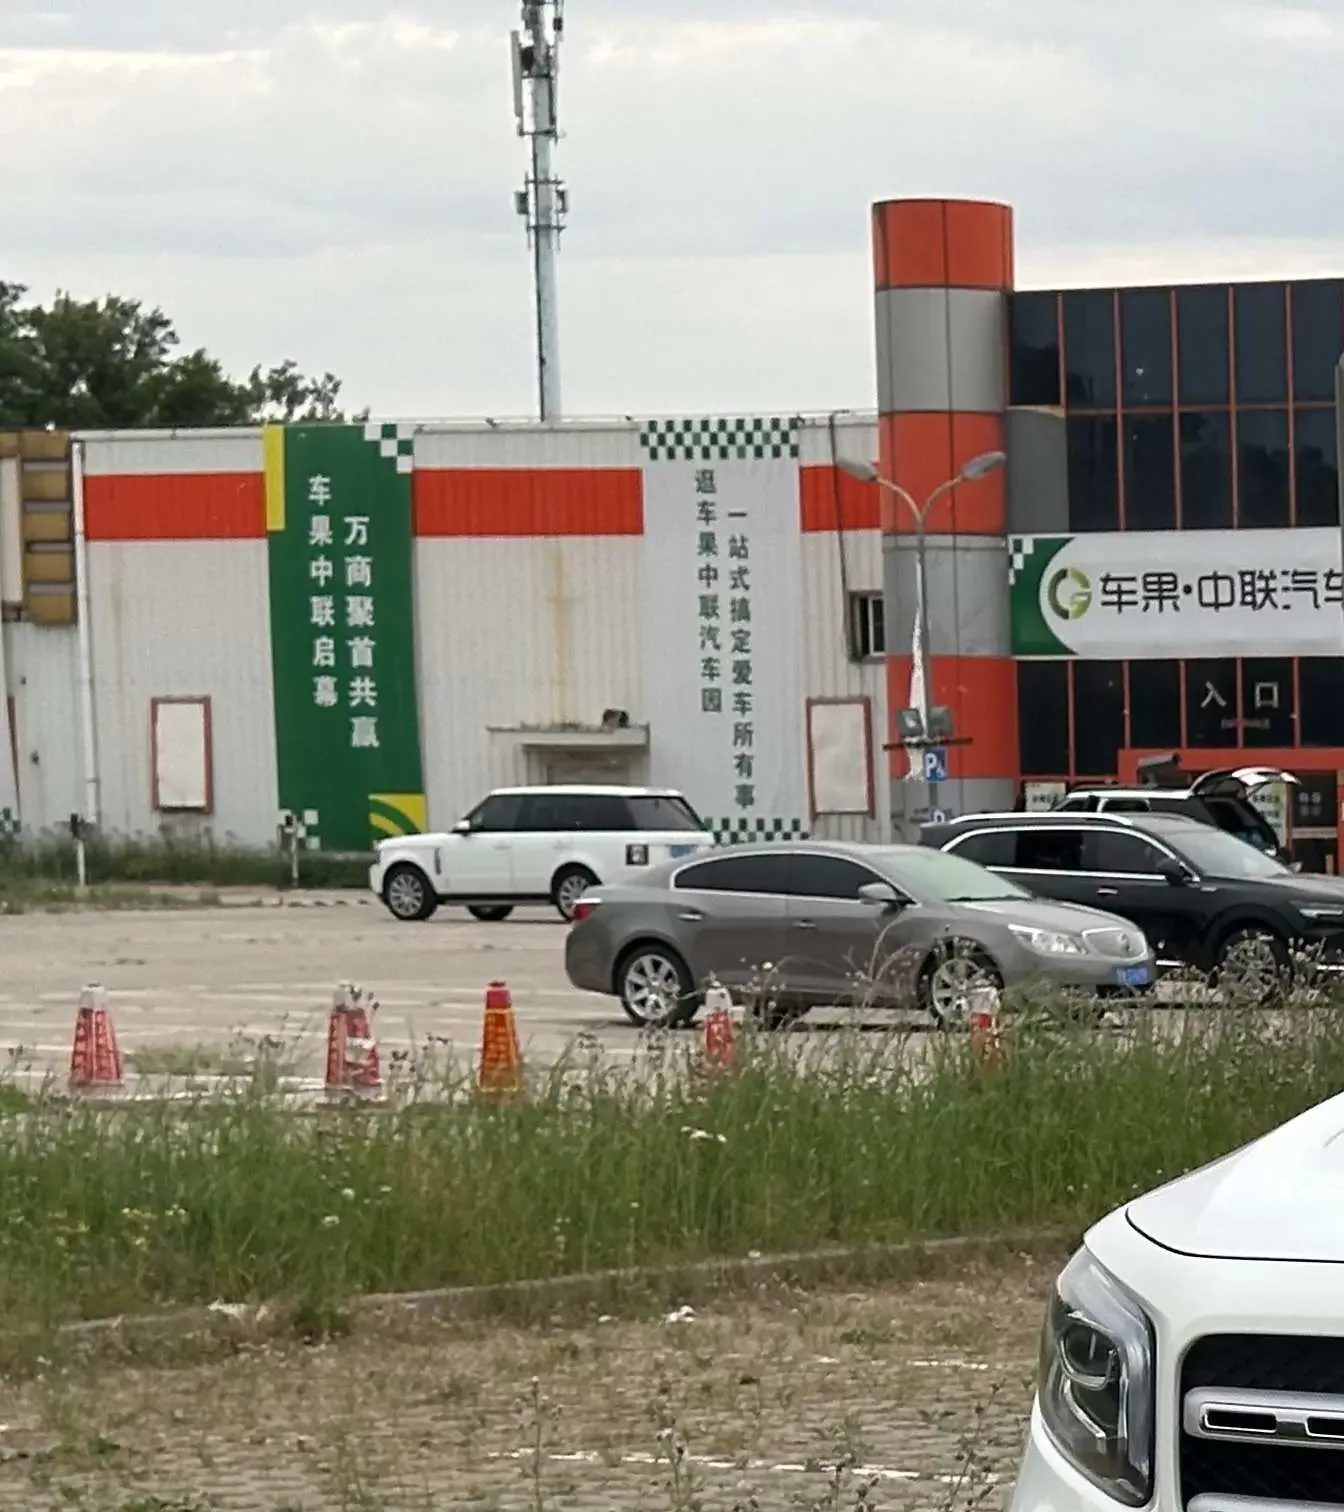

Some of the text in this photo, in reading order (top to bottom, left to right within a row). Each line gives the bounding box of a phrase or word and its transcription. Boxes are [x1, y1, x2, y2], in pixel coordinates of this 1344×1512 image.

[308, 474, 339, 707] 车果中联启幕
[344, 515, 380, 748] 万商聚首共赢
[728, 511, 755, 810] 一站式搞定爱车所有事
[1200, 681, 1279, 709] 入口
